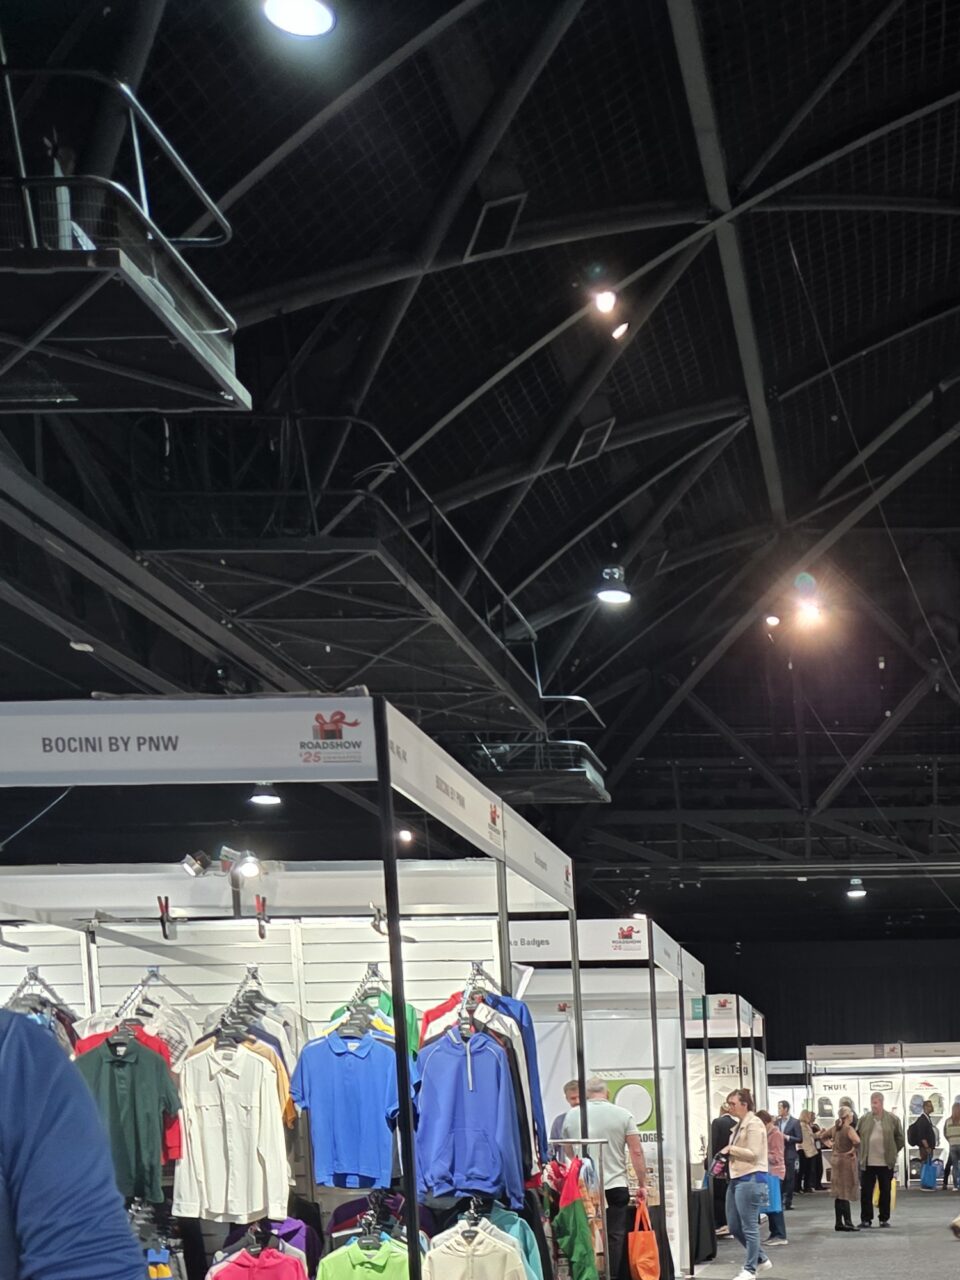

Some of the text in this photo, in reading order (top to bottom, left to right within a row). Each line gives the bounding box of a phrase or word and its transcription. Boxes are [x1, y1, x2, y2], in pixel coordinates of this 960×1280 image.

[41, 735, 180, 753] BOCINI BY PNW
[299, 740, 362, 750] ROADSHOW
[520, 937, 551, 948] Badges
